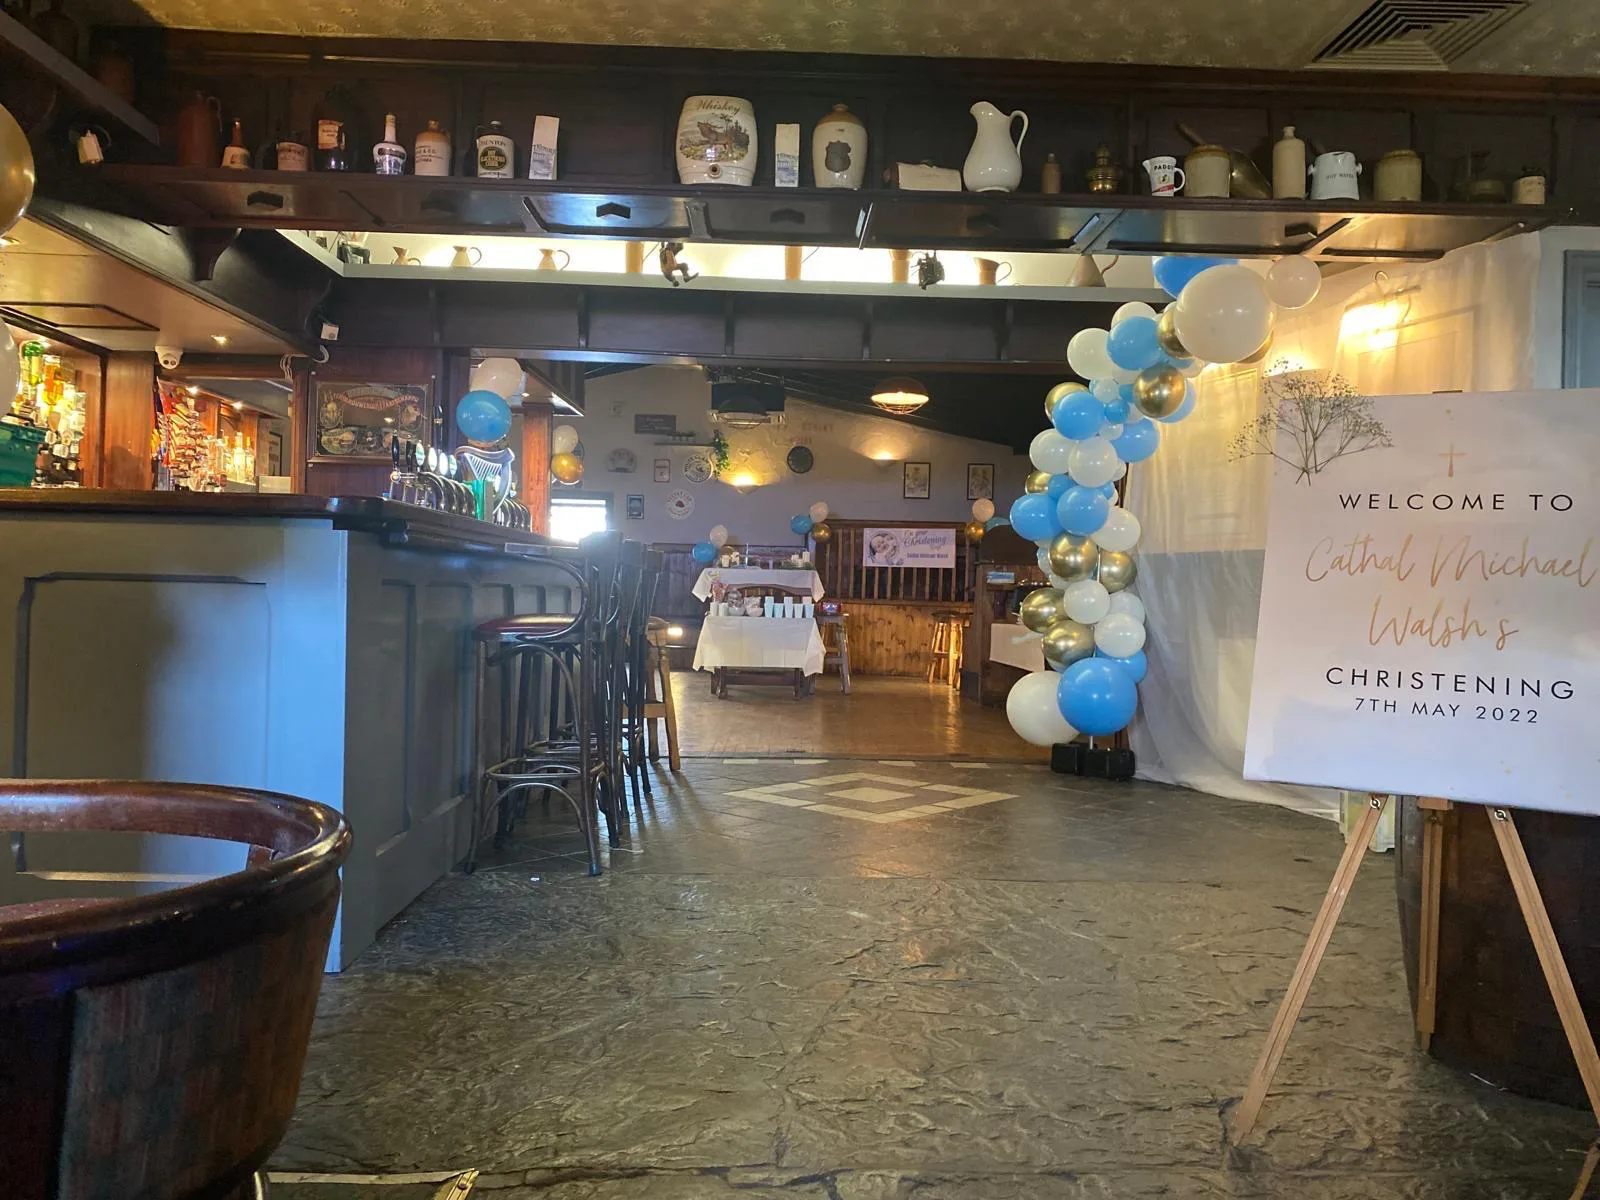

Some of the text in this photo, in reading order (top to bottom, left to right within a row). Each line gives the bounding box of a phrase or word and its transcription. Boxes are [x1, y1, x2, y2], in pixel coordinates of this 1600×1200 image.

[696, 99, 741, 115] Whiskey
[1339, 494, 1573, 512] WELCOME TO
[1305, 533, 1597, 588] Cathal Michael
[1326, 667, 1574, 700] CHRISTENING
[1355, 697, 1538, 724] 7TH MAY 2022
